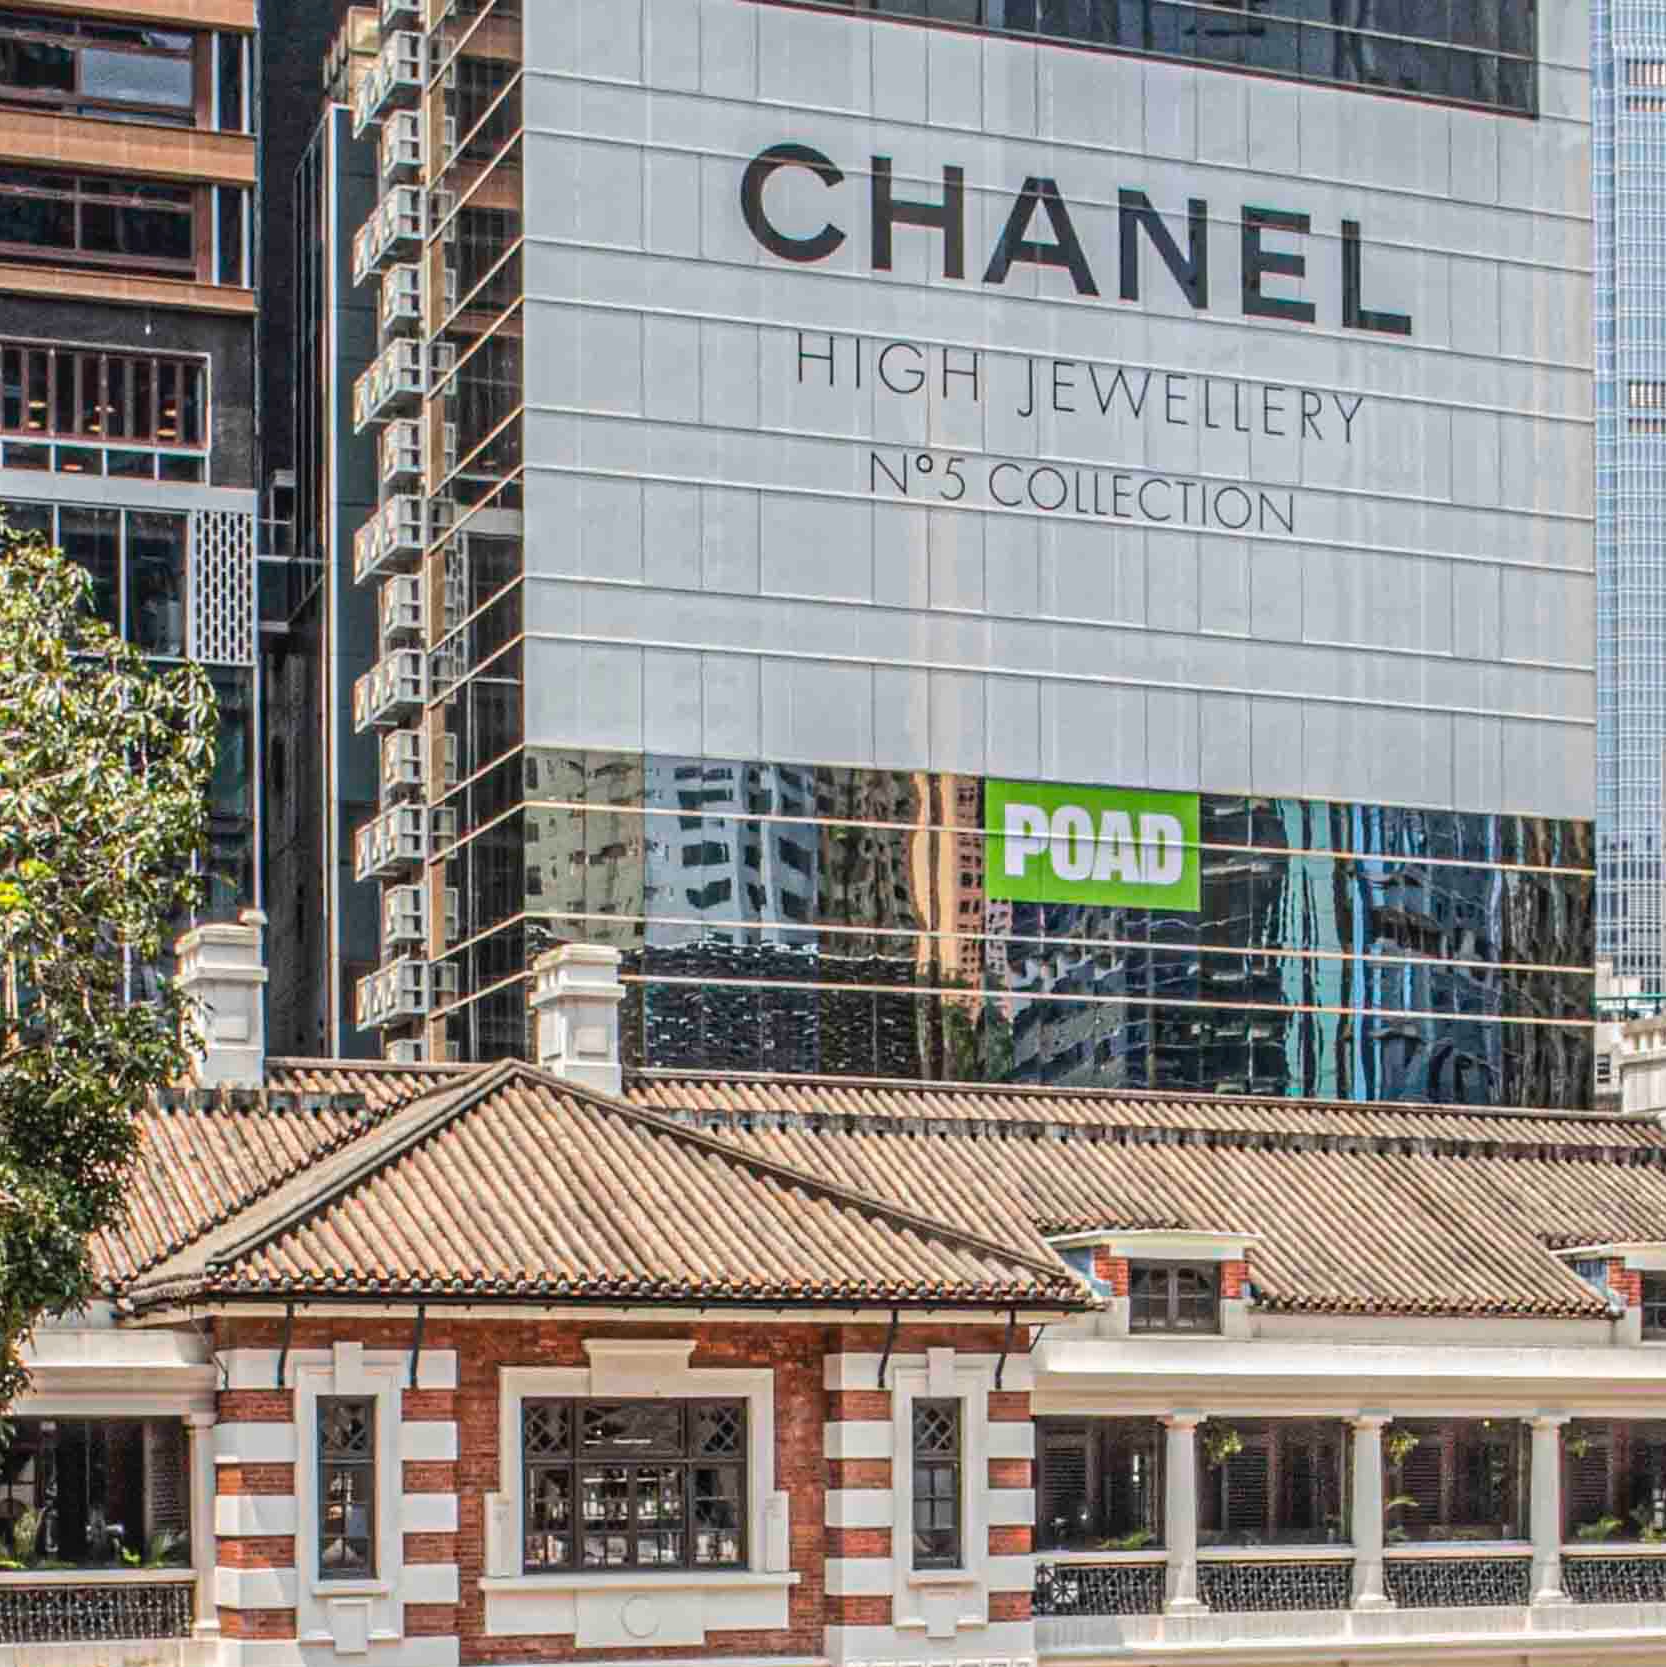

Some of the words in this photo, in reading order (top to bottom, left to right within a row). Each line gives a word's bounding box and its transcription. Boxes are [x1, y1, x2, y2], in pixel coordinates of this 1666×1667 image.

[740, 142, 1412, 335] CHANEL
[796, 332, 980, 401] HIGH
[1017, 359, 1365, 444] JEWELLERY
[989, 462, 1295, 534] COLLECTION
[1003, 803, 1183, 885] POAD
